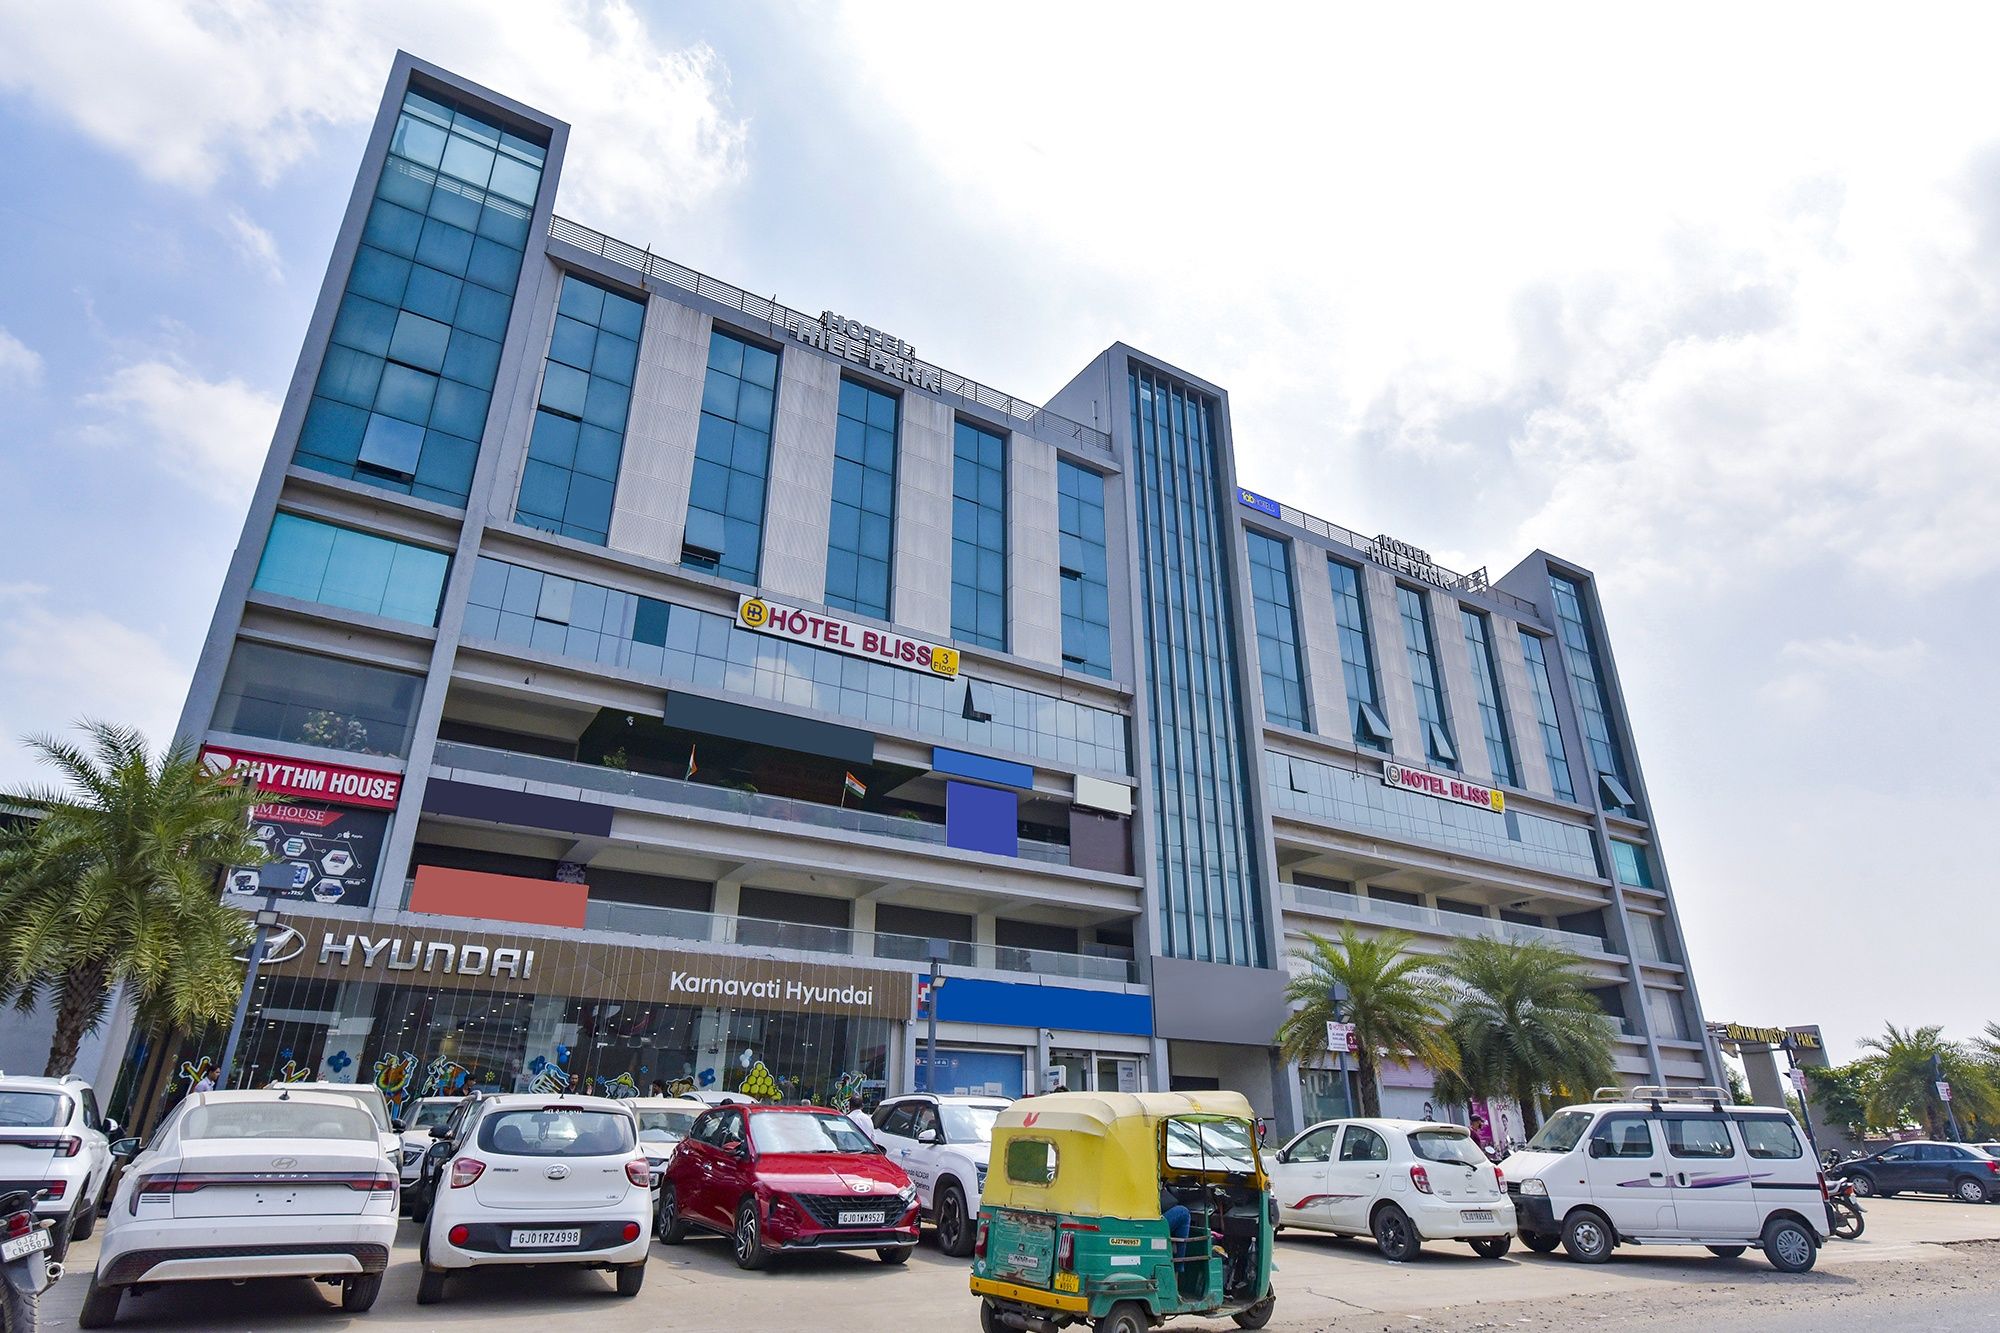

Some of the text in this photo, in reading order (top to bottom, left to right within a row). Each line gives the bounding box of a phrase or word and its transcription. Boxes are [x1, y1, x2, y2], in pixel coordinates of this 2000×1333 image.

[826, 310, 912, 361] HOTEL
[797, 321, 940, 395] HILL PARK
[1381, 534, 1432, 566] HOTEL
[1370, 545, 1451, 592] HILL PARK
[862, 630, 932, 667] BLISS
[933, 661, 956, 674] Floor
[232, 758, 397, 800] RHYTHM HOUSE
[1401, 768, 1490, 806] HOTEL BLISS
[275, 805, 326, 821] HOUSE
[318, 932, 535, 980] HYUNDAI
[670, 971, 873, 1006] Karnavati Hyundai
[1726, 1024, 1759, 1042] SURYAM
[1795, 1032, 1815, 1048] PARK
[843, 1213, 884, 1223] GJ01WM9527
[12, 1238, 47, 1256] CN3587
[16, 1233, 39, 1247] GJ27
[519, 1231, 579, 1244] GJ01RZ4998
